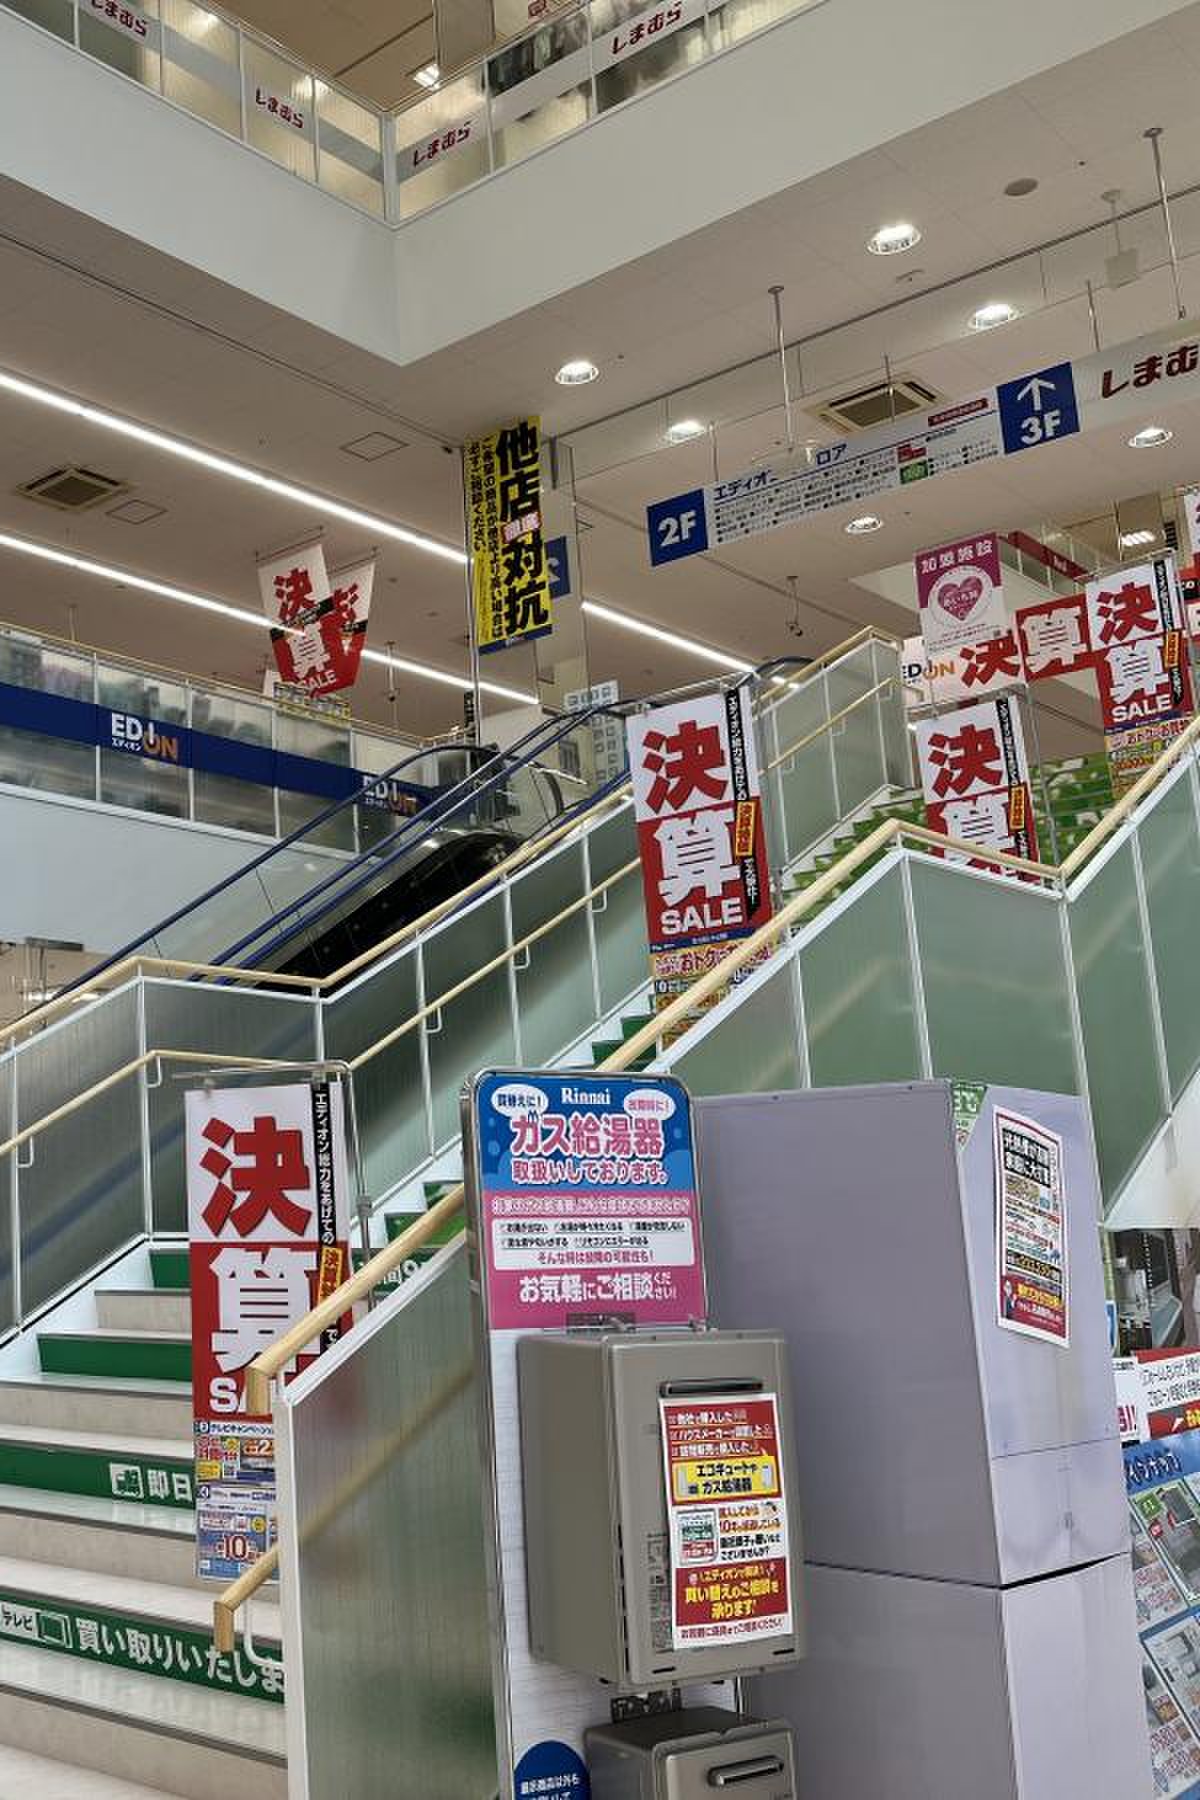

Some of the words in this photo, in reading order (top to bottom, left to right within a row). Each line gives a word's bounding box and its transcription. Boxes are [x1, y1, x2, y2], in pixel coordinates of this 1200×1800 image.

[612, 2, 682, 54] しまむら
[255, 87, 303, 128] しまむら
[413, 121, 471, 166] しまむら
[1021, 410, 1061, 445] 3F
[496, 422, 541, 521] 他店
[657, 510, 696, 547] 2F
[502, 529, 548, 634] 対抗
[1097, 582, 1170, 705] 決算
[1111, 694, 1172, 723] SALE
[111, 712, 179, 761] EDION
[643, 720, 742, 908] 決算
[661, 897, 743, 936] SALE
[561, 1087, 611, 1105] Rinnai
[511, 1114, 664, 1157] ガス給湯器
[512, 1158, 668, 1184] 取扱いしております。
[147, 1468, 192, 1502] 即日
[2, 1609, 35, 1631] テレビ
